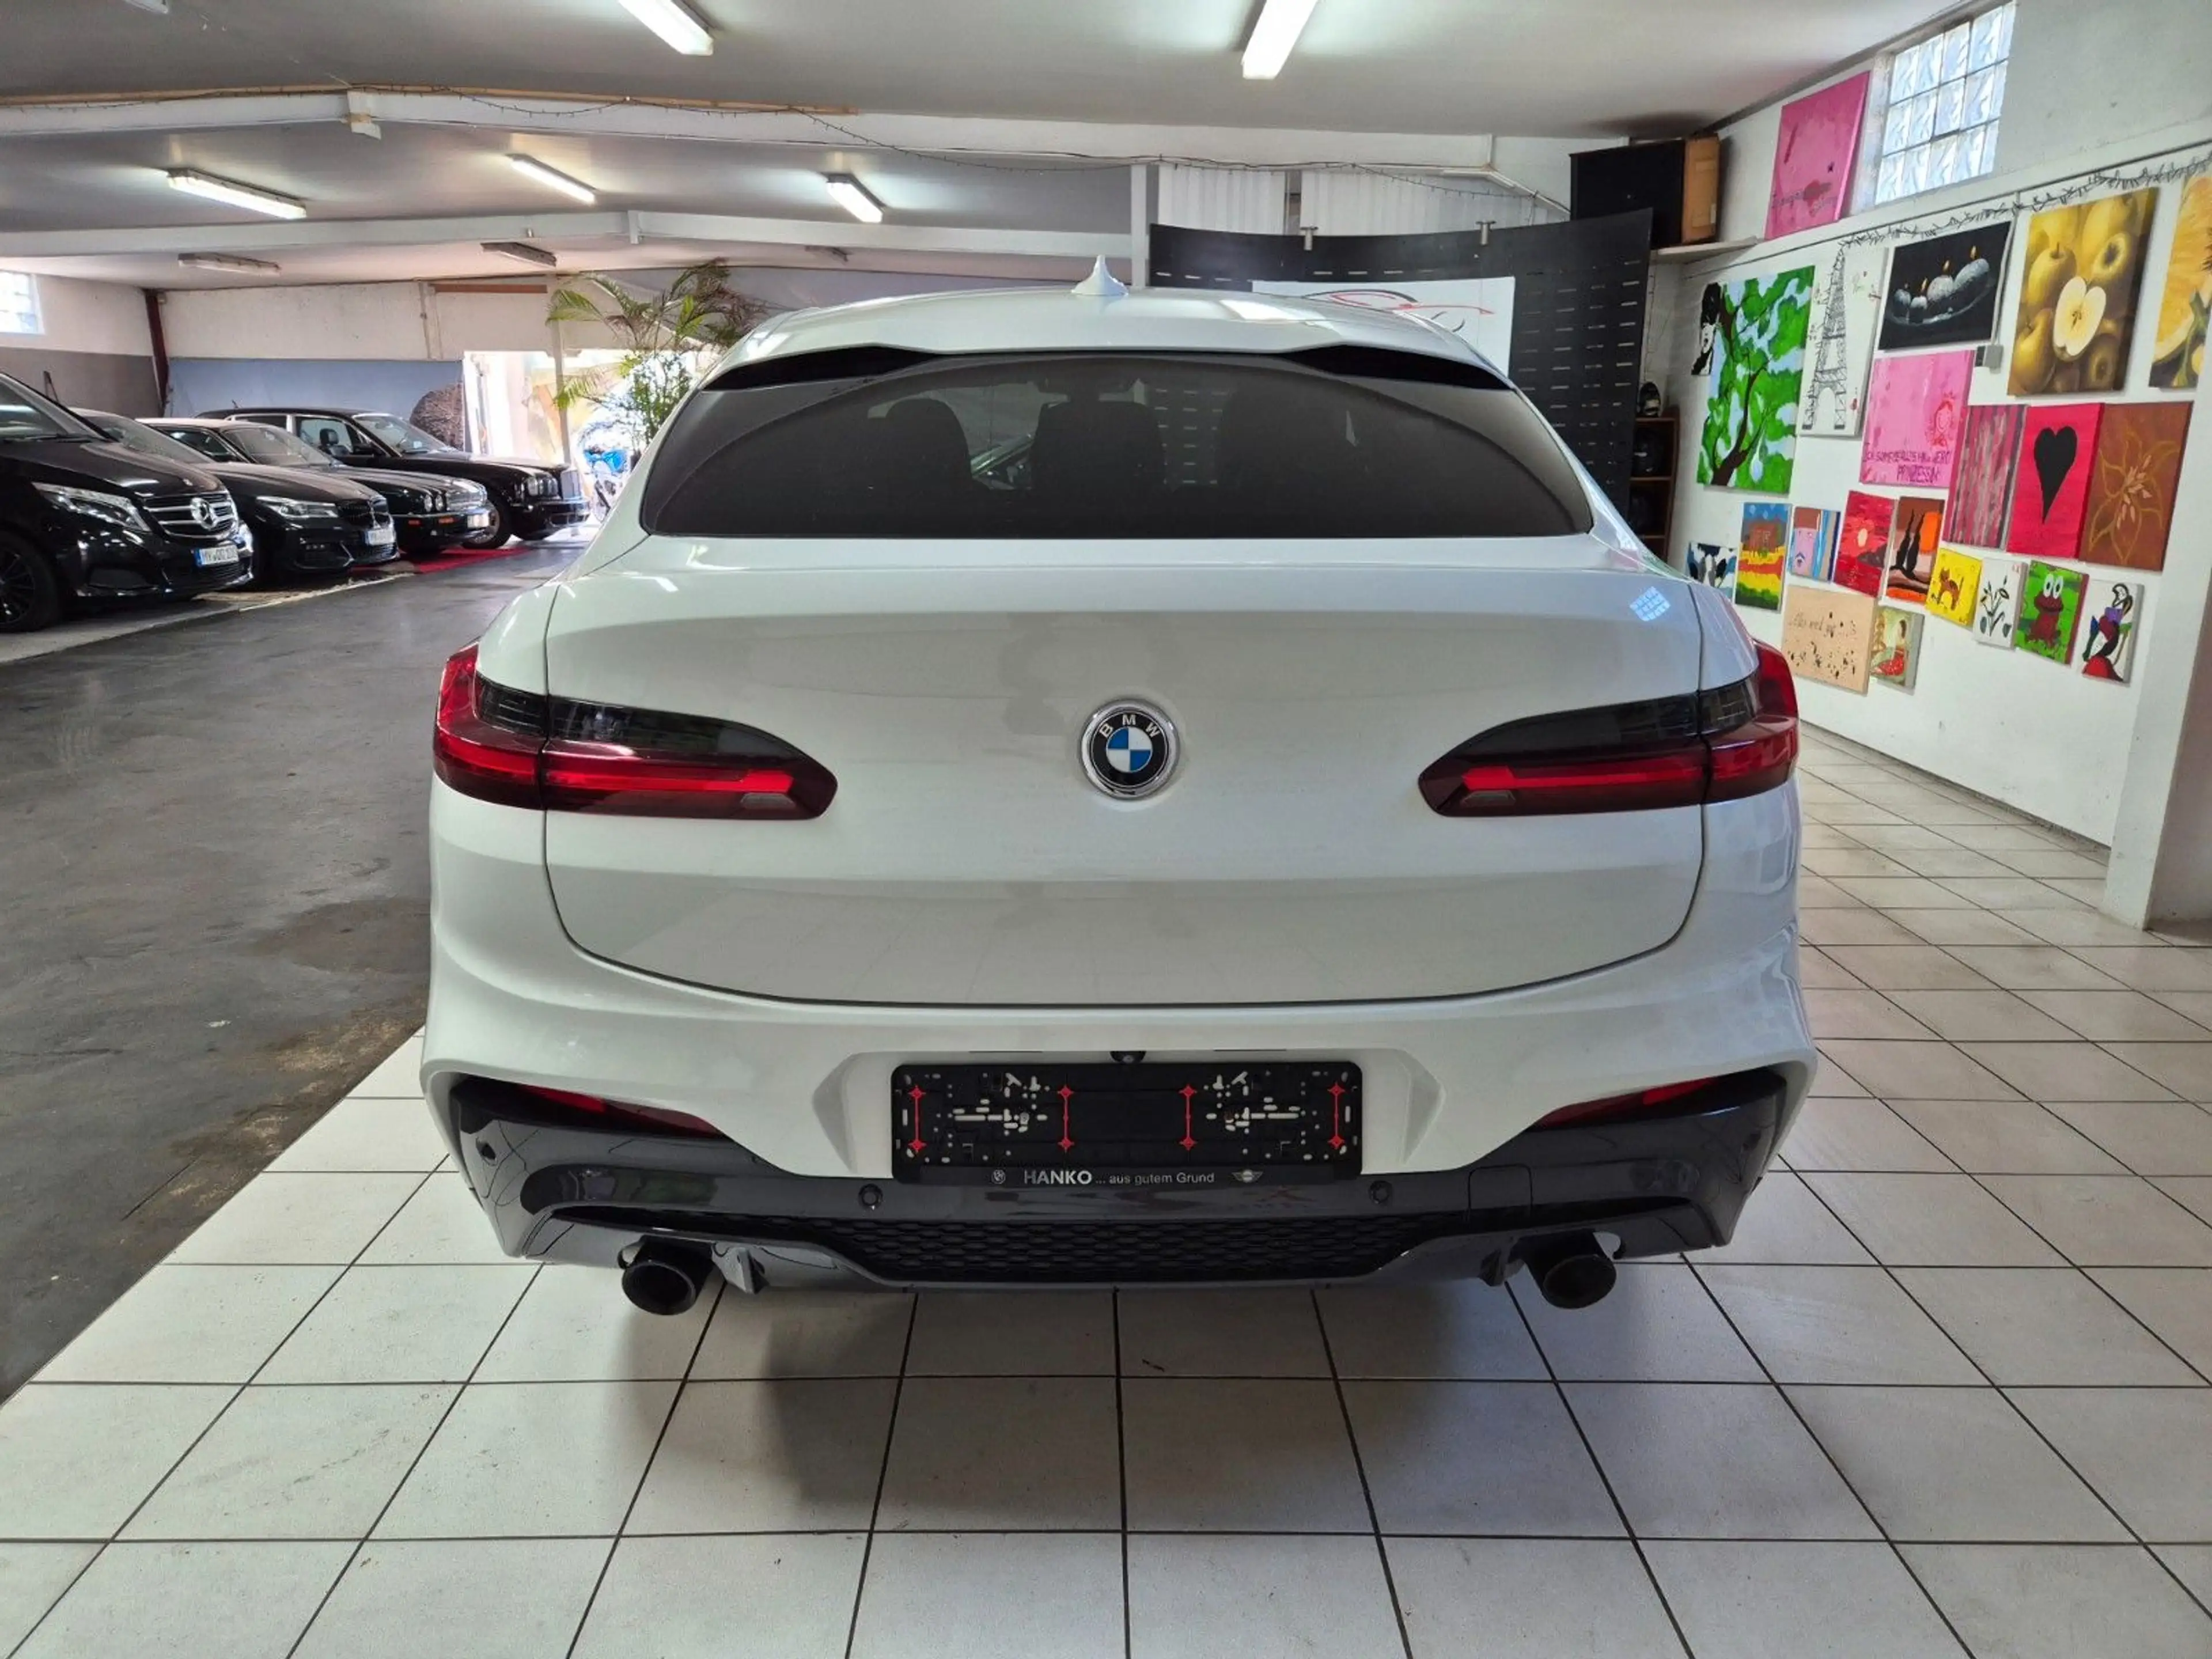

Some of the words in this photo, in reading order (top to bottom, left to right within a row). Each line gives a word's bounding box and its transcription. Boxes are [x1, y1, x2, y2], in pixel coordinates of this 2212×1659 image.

[1099, 714, 1161, 738] BMW
[1024, 1170, 1092, 1184] HANKO
[1109, 1175, 1130, 1184] aus
[1134, 1173, 1172, 1185] gutem
[1176, 1172, 1214, 1183] Grund
